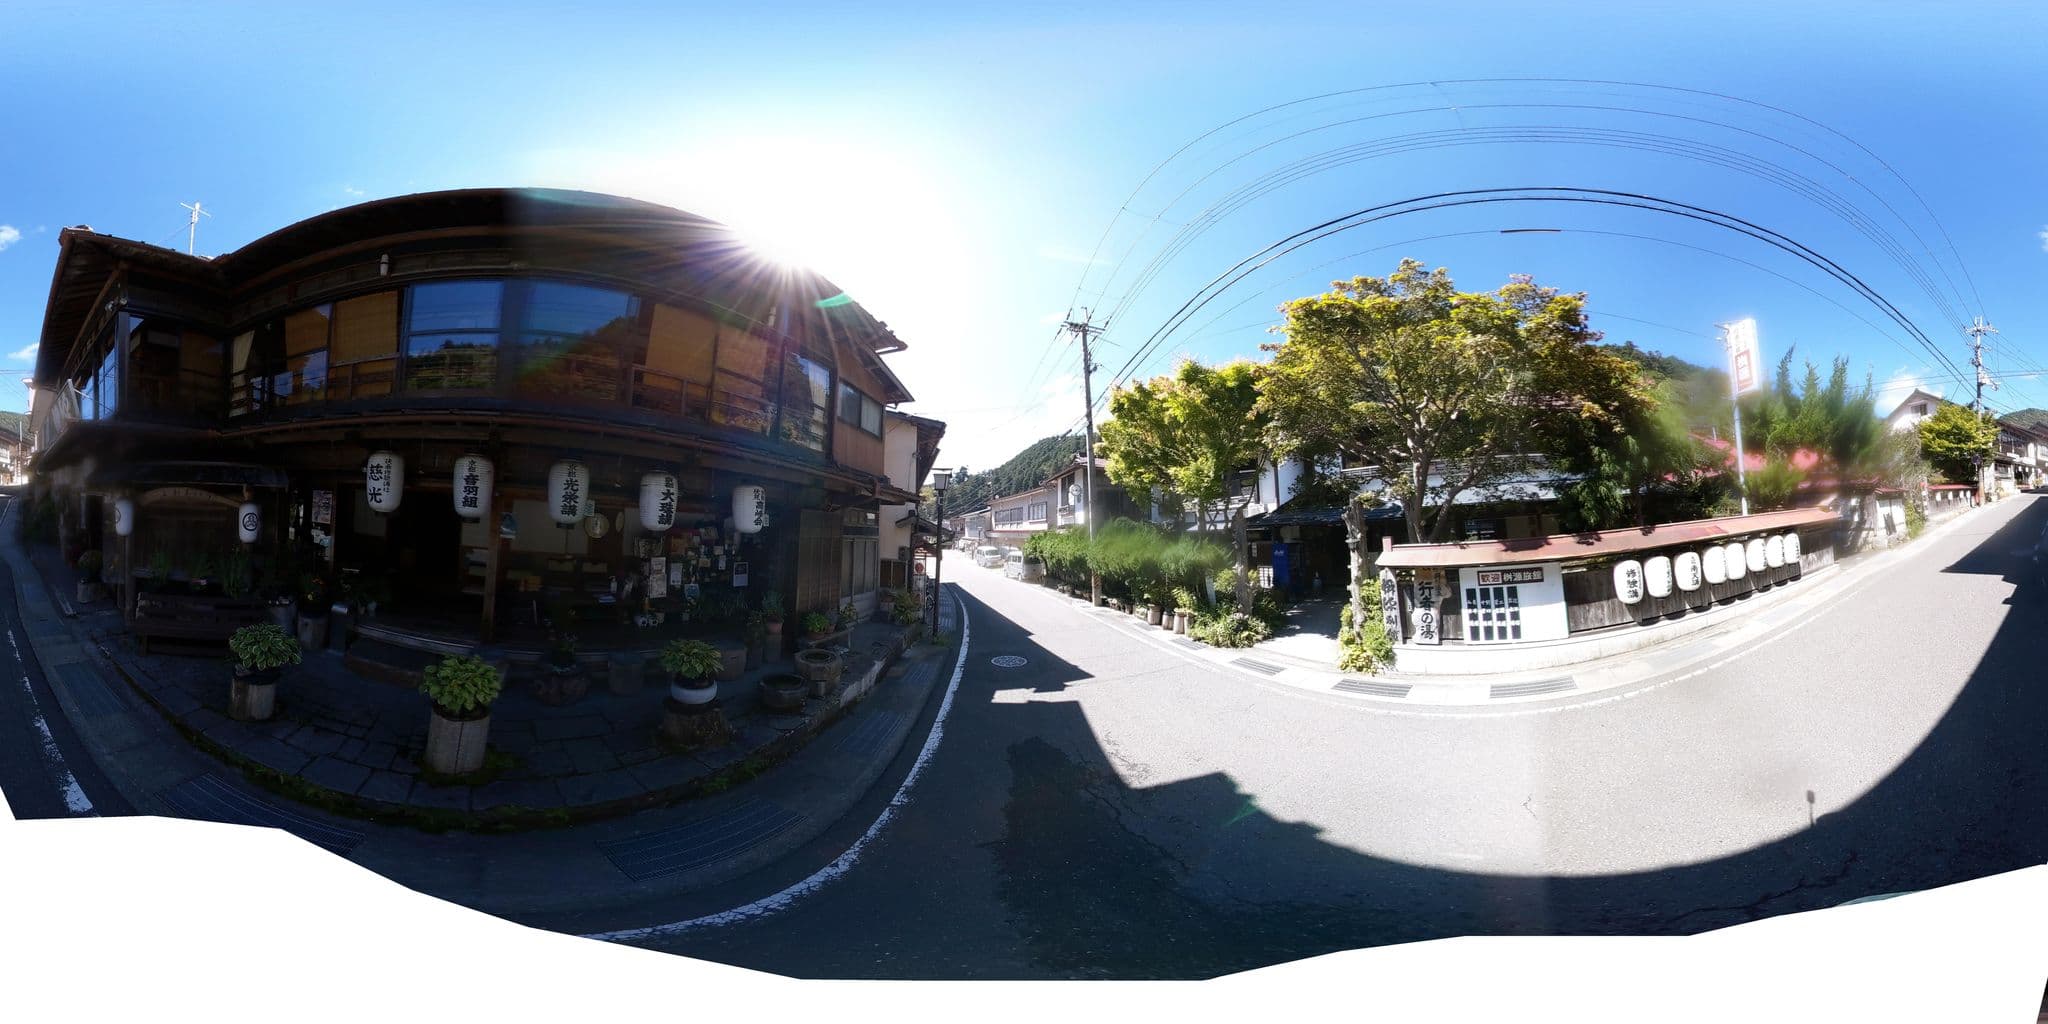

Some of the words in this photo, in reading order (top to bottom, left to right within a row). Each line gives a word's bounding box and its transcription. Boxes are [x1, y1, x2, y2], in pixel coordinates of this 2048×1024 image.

[368, 463, 383, 504] 慈光
[462, 473, 479, 508] 音羽組
[1418, 580, 1435, 640] 行者の湯
